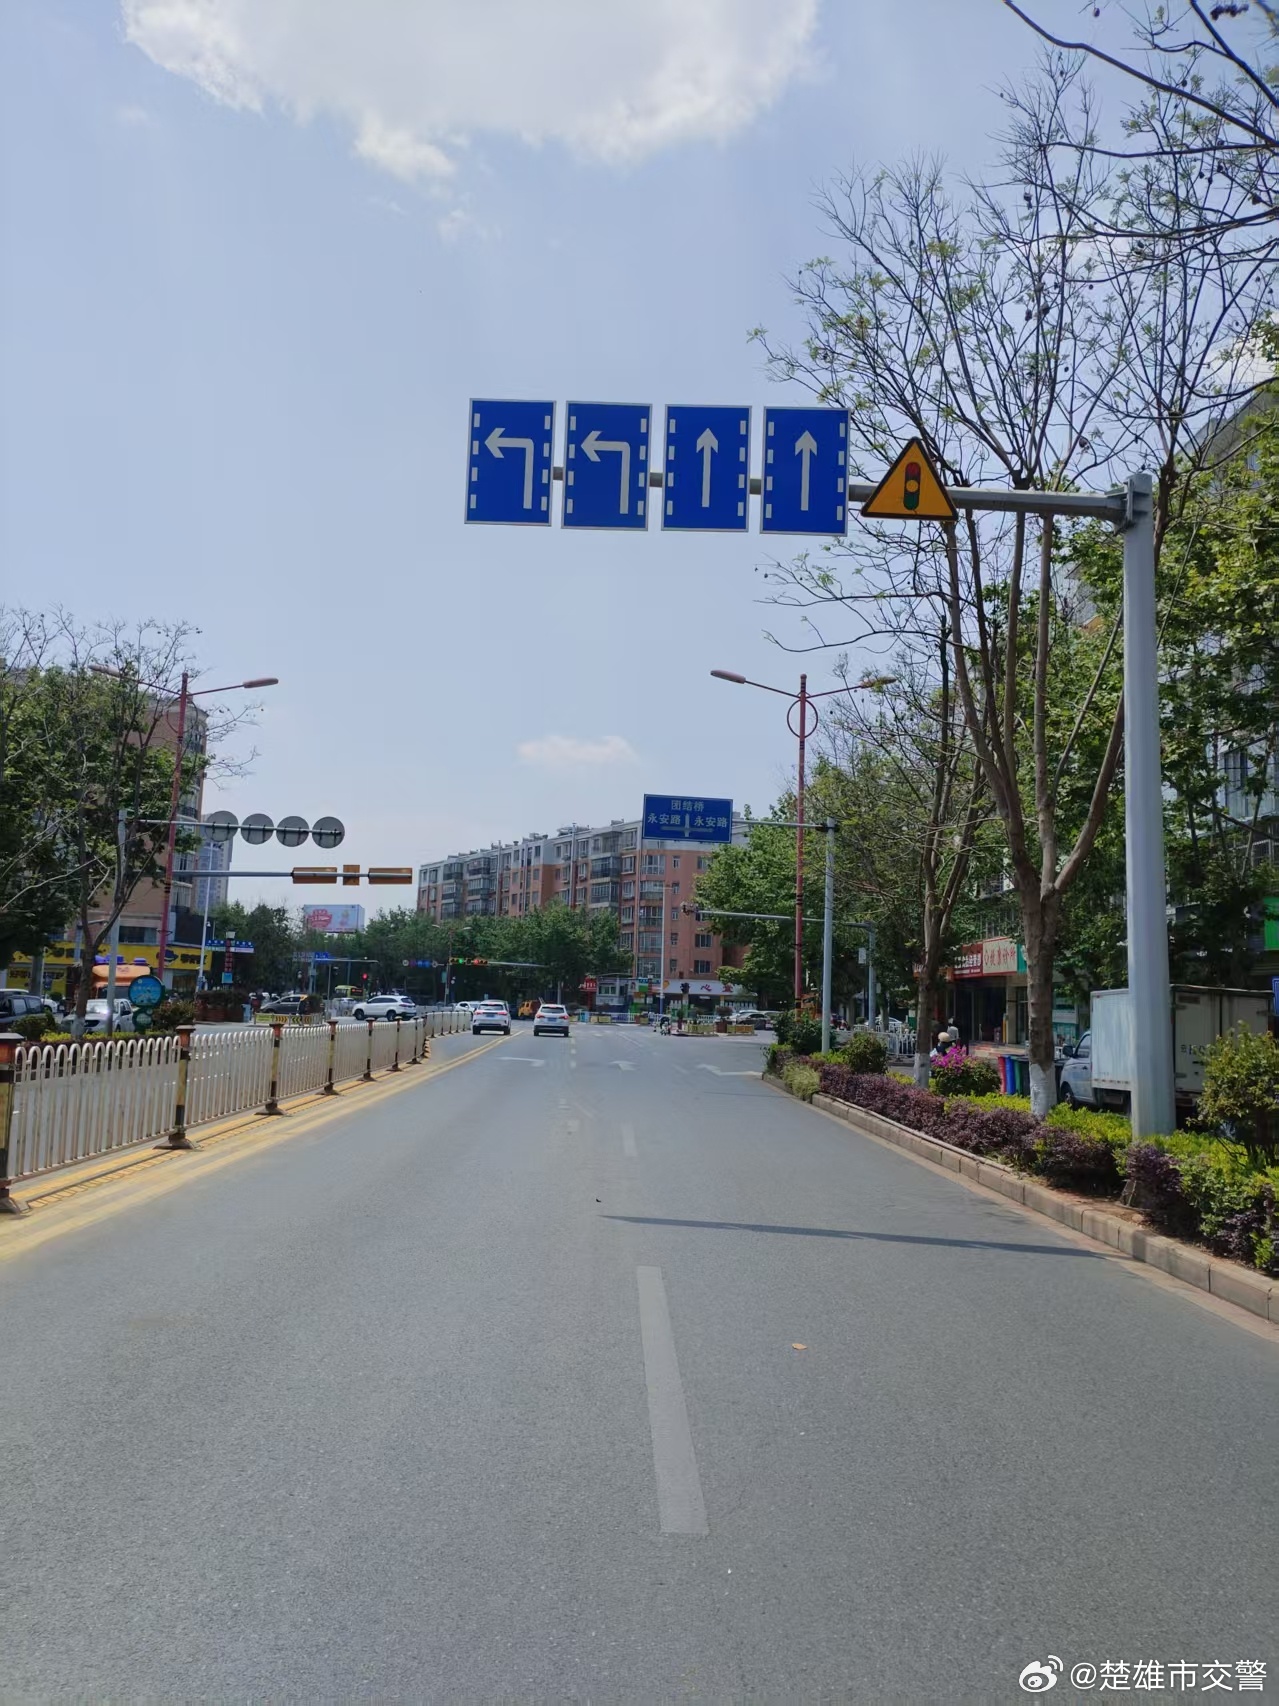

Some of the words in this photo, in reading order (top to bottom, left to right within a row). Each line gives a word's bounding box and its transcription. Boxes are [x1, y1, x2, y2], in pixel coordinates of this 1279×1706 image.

[671, 800, 704, 812] 团结桥
[648, 813, 681, 825] 永安路
[694, 816, 728, 828] 永安路
